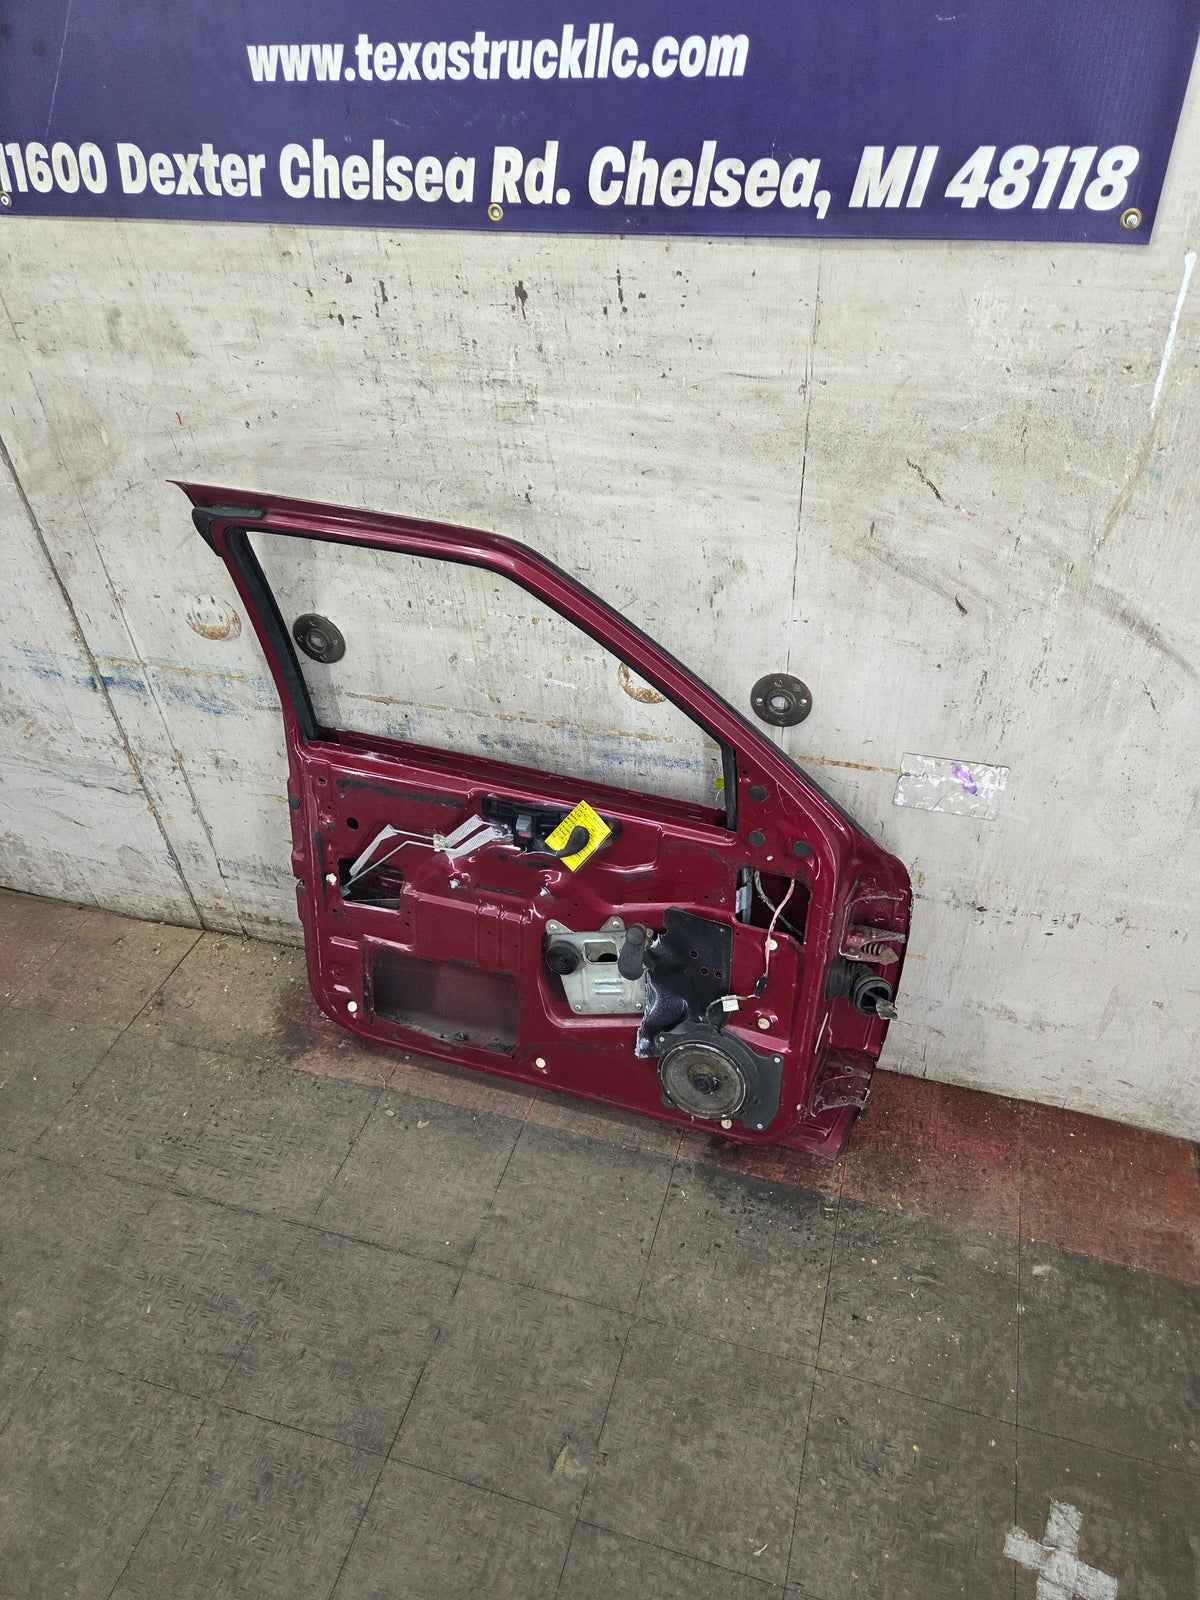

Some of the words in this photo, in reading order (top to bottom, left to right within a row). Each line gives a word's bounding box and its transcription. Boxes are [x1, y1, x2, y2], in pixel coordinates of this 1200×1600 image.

[246, 22, 750, 82] www.texastruckllc.com
[116, 142, 267, 198] Dexter
[279, 138, 476, 204] Chelsea
[490, 140, 571, 206] Rd.
[588, 140, 832, 220] Chelsea,
[848, 145, 940, 208] MI
[944, 144, 1140, 212] 48118
